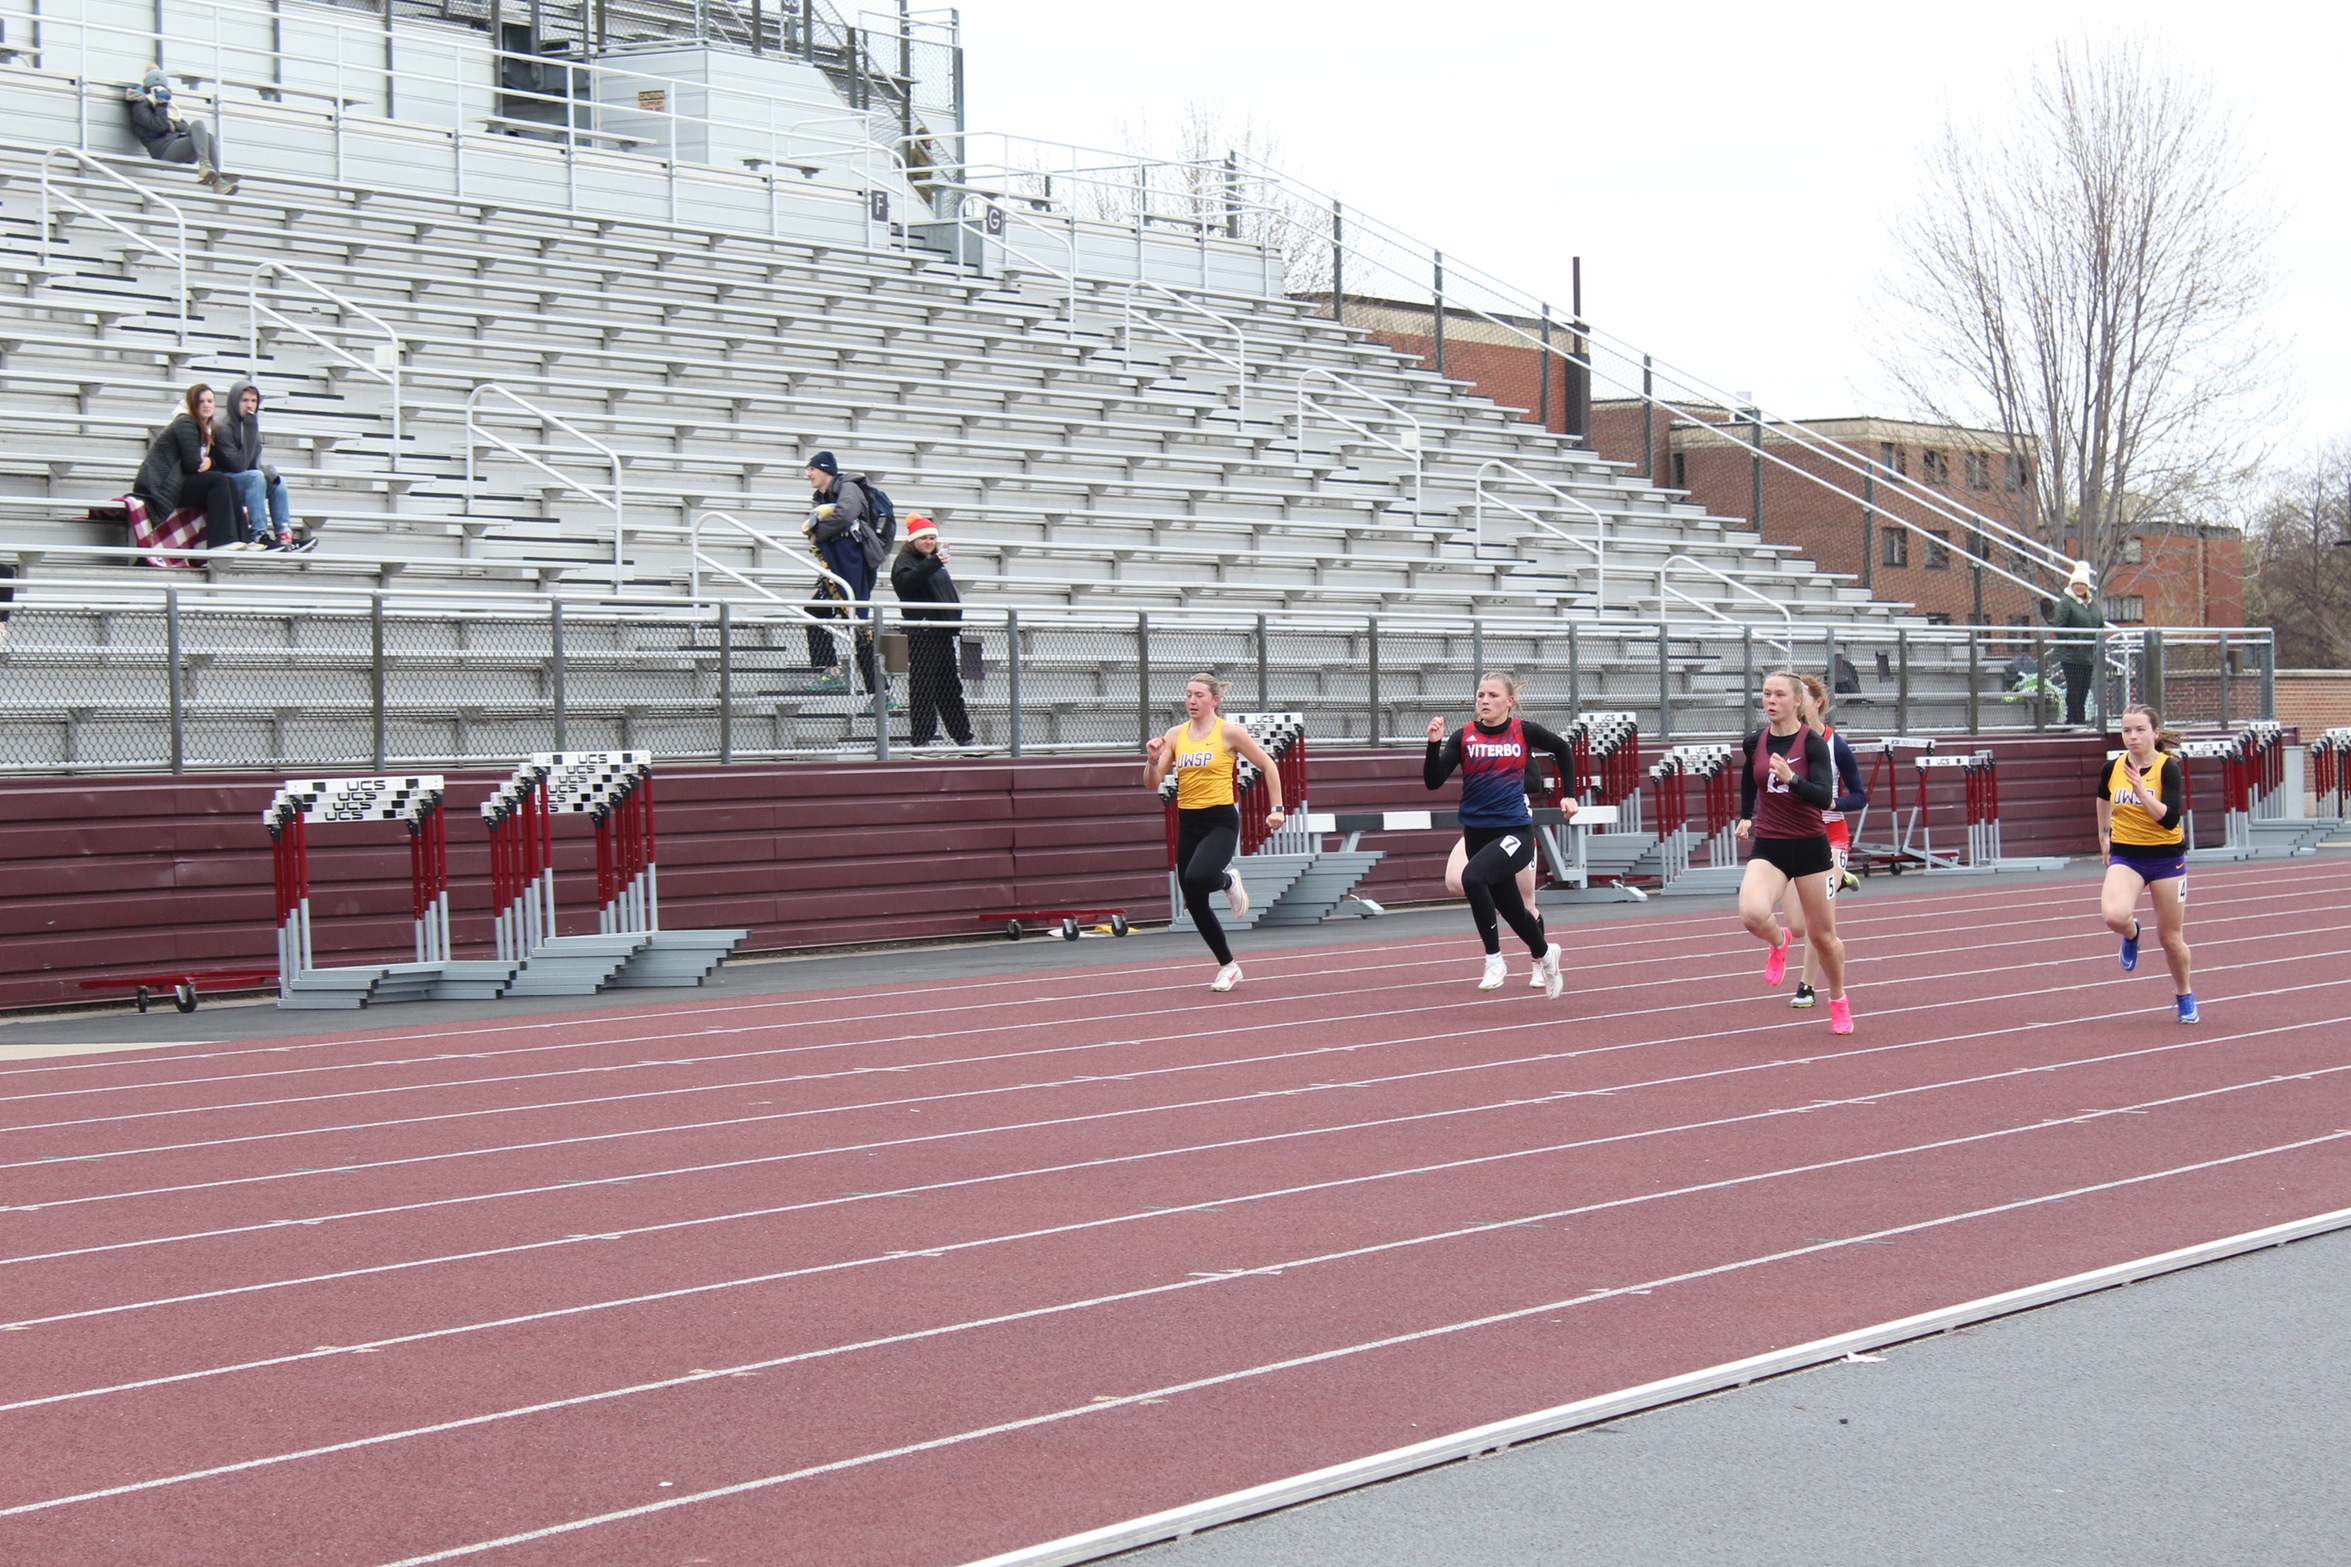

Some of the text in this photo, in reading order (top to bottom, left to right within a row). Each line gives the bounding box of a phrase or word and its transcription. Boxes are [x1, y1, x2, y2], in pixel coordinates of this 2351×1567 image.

[875, 194, 884, 215] F
[988, 209, 1000, 230] G
[1255, 715, 1275, 723] UCS
[1467, 743, 1521, 758] VITERBO
[1696, 746, 1710, 754] UCS
[578, 754, 608, 764] UCS
[1177, 752, 1213, 769] UWSP
[566, 765, 596, 774] UCS
[558, 775, 588, 784] UCS
[347, 780, 386, 791] UCS
[548, 784, 578, 793] UCS
[337, 791, 377, 801] UCS
[332, 802, 372, 811] UCS
[324, 811, 364, 821] UCS
[1505, 836, 1518, 849] 7
[1839, 850, 1847, 868] 6
[1828, 876, 1834, 898] 5
[2180, 880, 2186, 900] 4
